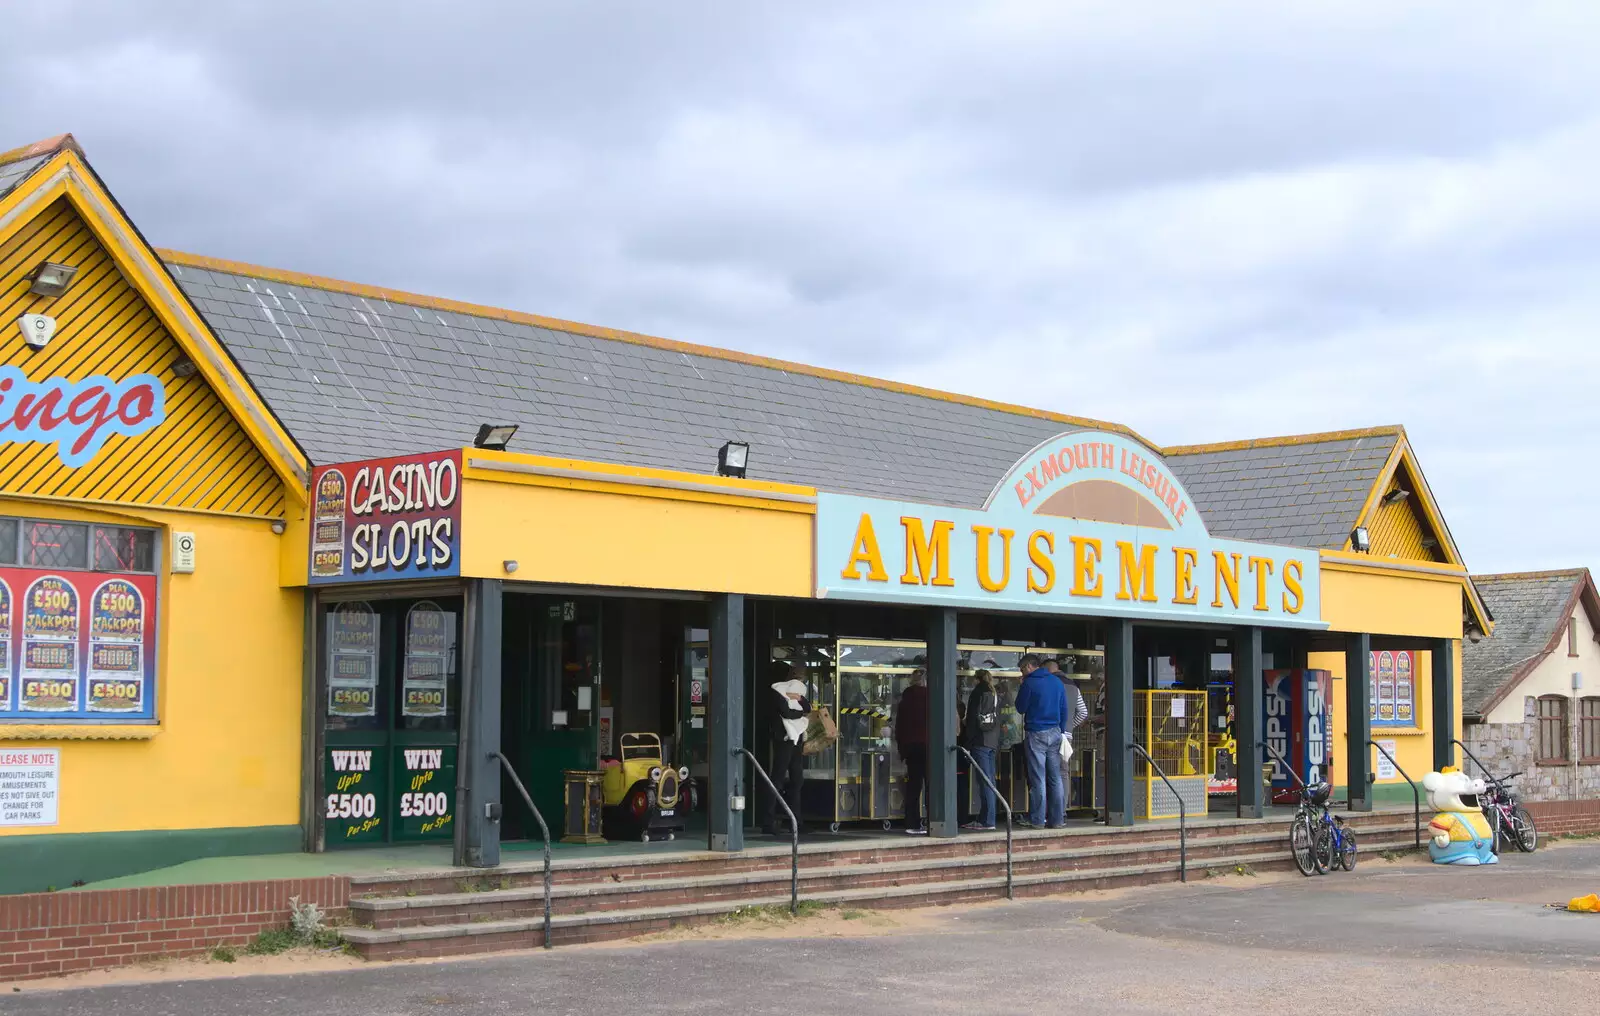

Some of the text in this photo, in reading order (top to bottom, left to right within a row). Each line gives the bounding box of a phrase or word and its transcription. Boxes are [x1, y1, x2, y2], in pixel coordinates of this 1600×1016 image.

[321, 480, 341, 495] £500
[350, 458, 457, 515] CASINO
[1013, 442, 1189, 528] EXMOUTH LEISURE
[351, 517, 451, 570] SLOTS
[315, 552, 340, 565] £500
[841, 512, 1304, 615] AMUSEMENTS
[42, 580, 62, 590] PLAY
[109, 583, 128, 593] PLAY
[34, 590, 70, 609] £500
[101, 593, 135, 612] £500
[26, 613, 76, 629] JACKPOT
[94, 617, 141, 631] JACKPOT
[27, 682, 72, 698] £500
[93, 682, 137, 698] £500
[334, 691, 370, 703] £500
[408, 691, 441, 704] £500
[1266, 687, 1287, 780] PEPSI
[1308, 681, 1325, 790] PEPSI
[32, 754, 55, 764] NOTE
[331, 750, 372, 771] WIN
[404, 749, 442, 770] WIN
[27, 771, 54, 779] LEISURE
[1, 781, 47, 789] AMUSEMENTS
[25, 791, 41, 799] GIVE
[42, 791, 54, 799] OUT
[30, 801, 44, 809] FOR
[326, 793, 376, 818] £500
[400, 792, 447, 817] £500
[5, 811, 41, 820] CAR PARKS
